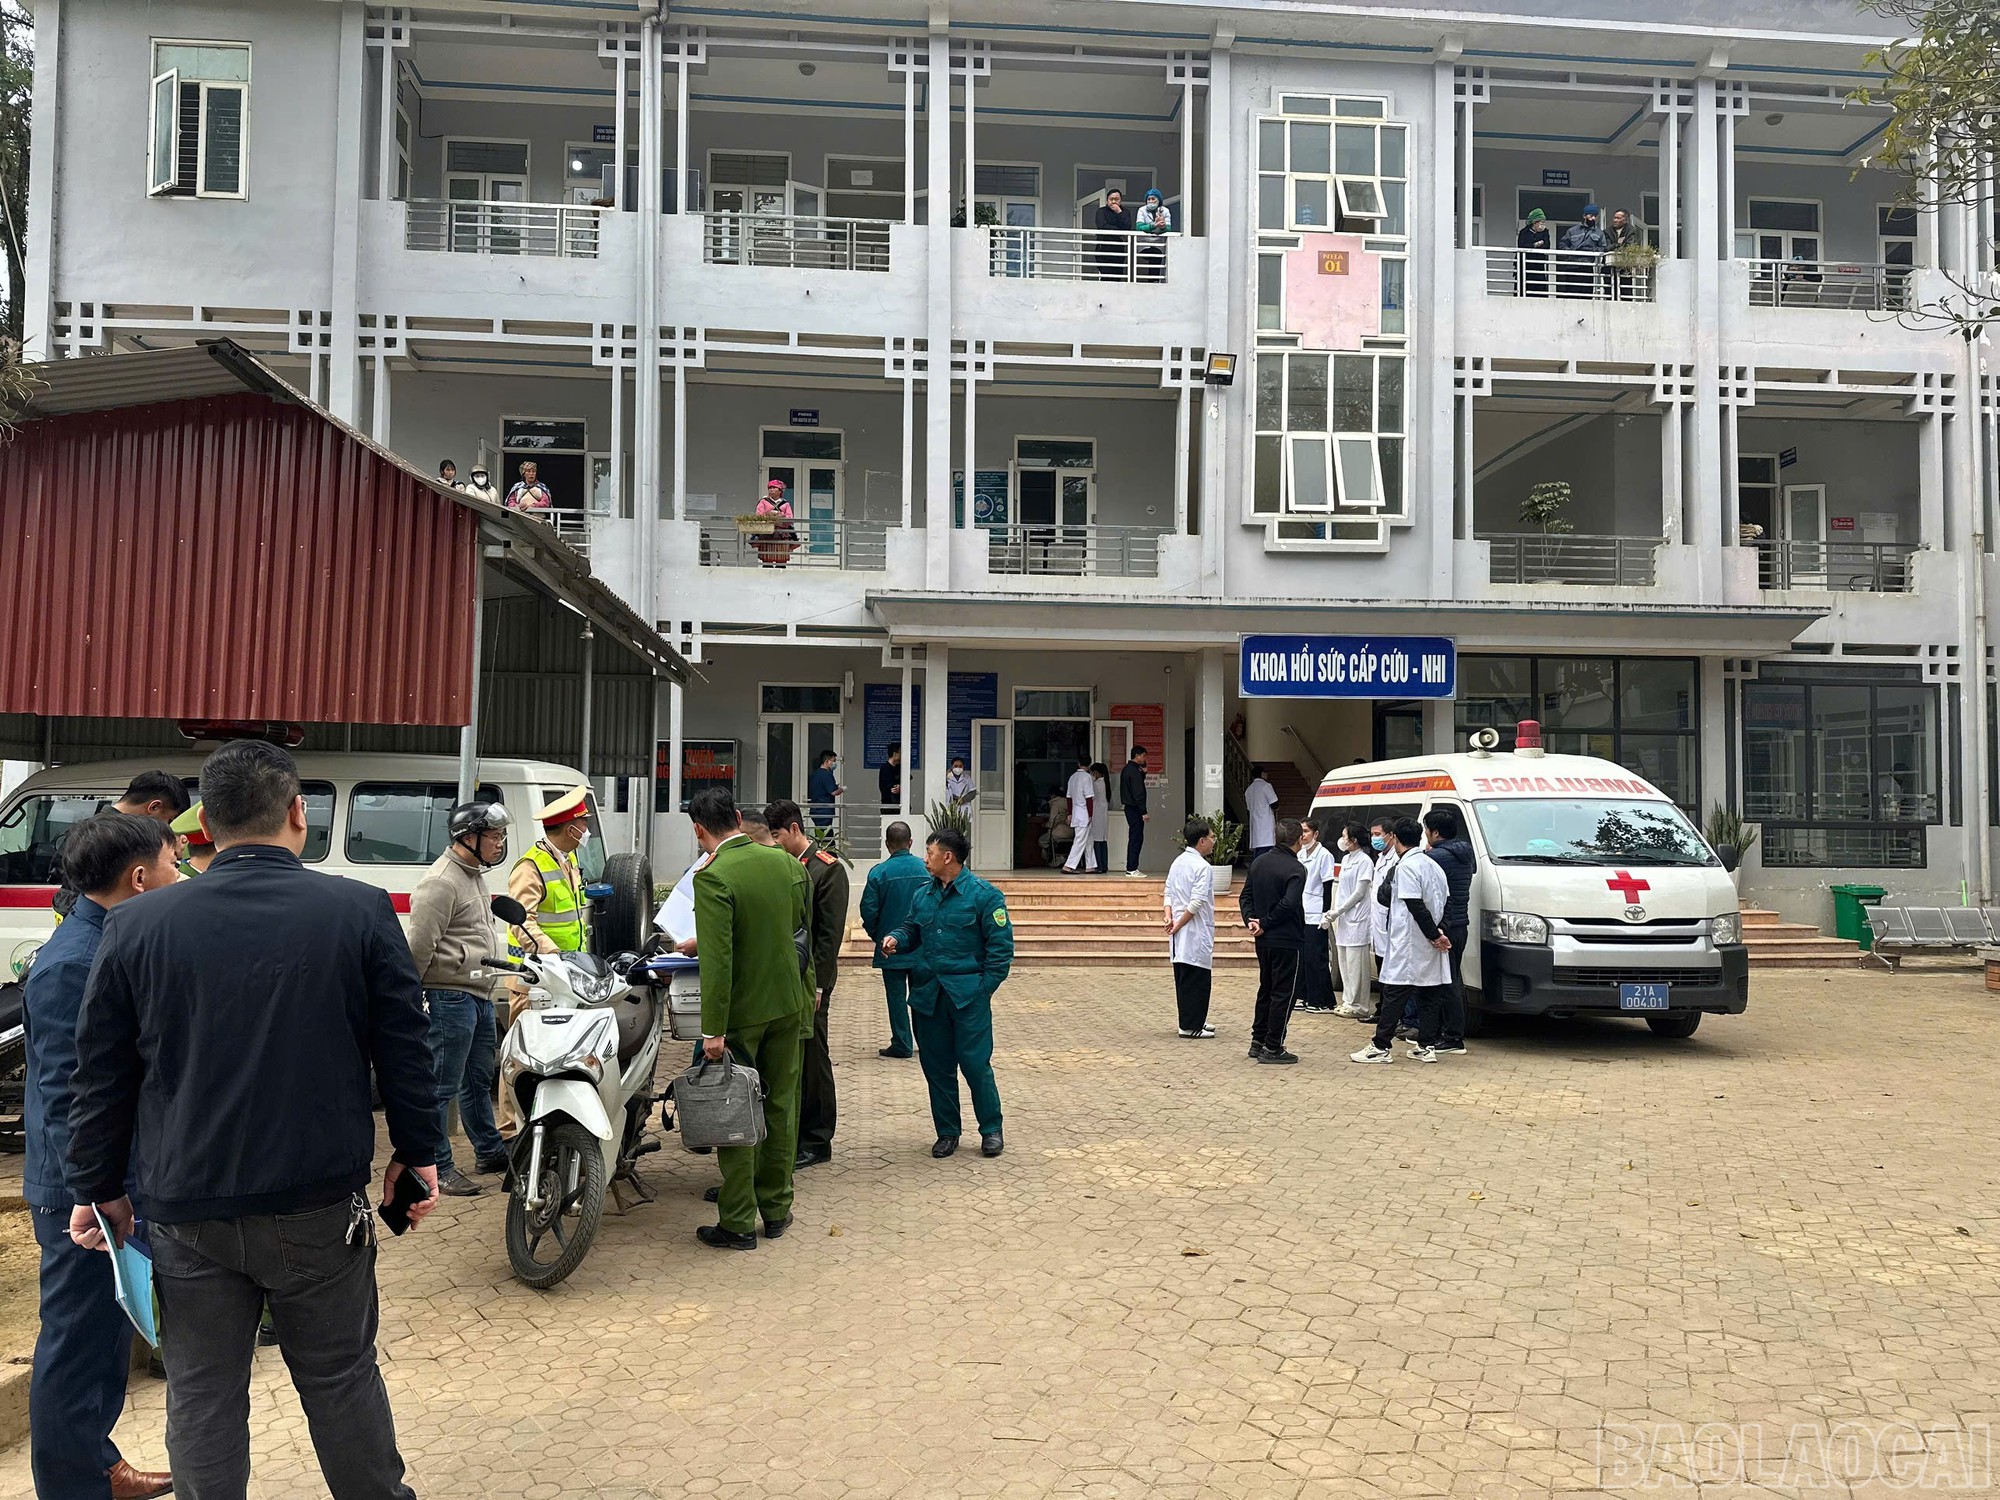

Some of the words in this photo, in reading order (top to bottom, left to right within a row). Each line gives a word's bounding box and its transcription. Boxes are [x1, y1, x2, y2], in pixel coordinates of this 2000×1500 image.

[1325, 260, 1342, 272] 01
[1250, 652, 1288, 682] KHOA
[1290, 643, 1314, 682] HỒI
[1317, 647, 1346, 683] SỨC
[1349, 643, 1378, 683] CẤP
[1380, 647, 1409, 683] CỨU
[1421, 654, 1446, 683] NHI
[1634, 985, 1655, 996] 21A
[1626, 997, 1662, 1008] 004.01
